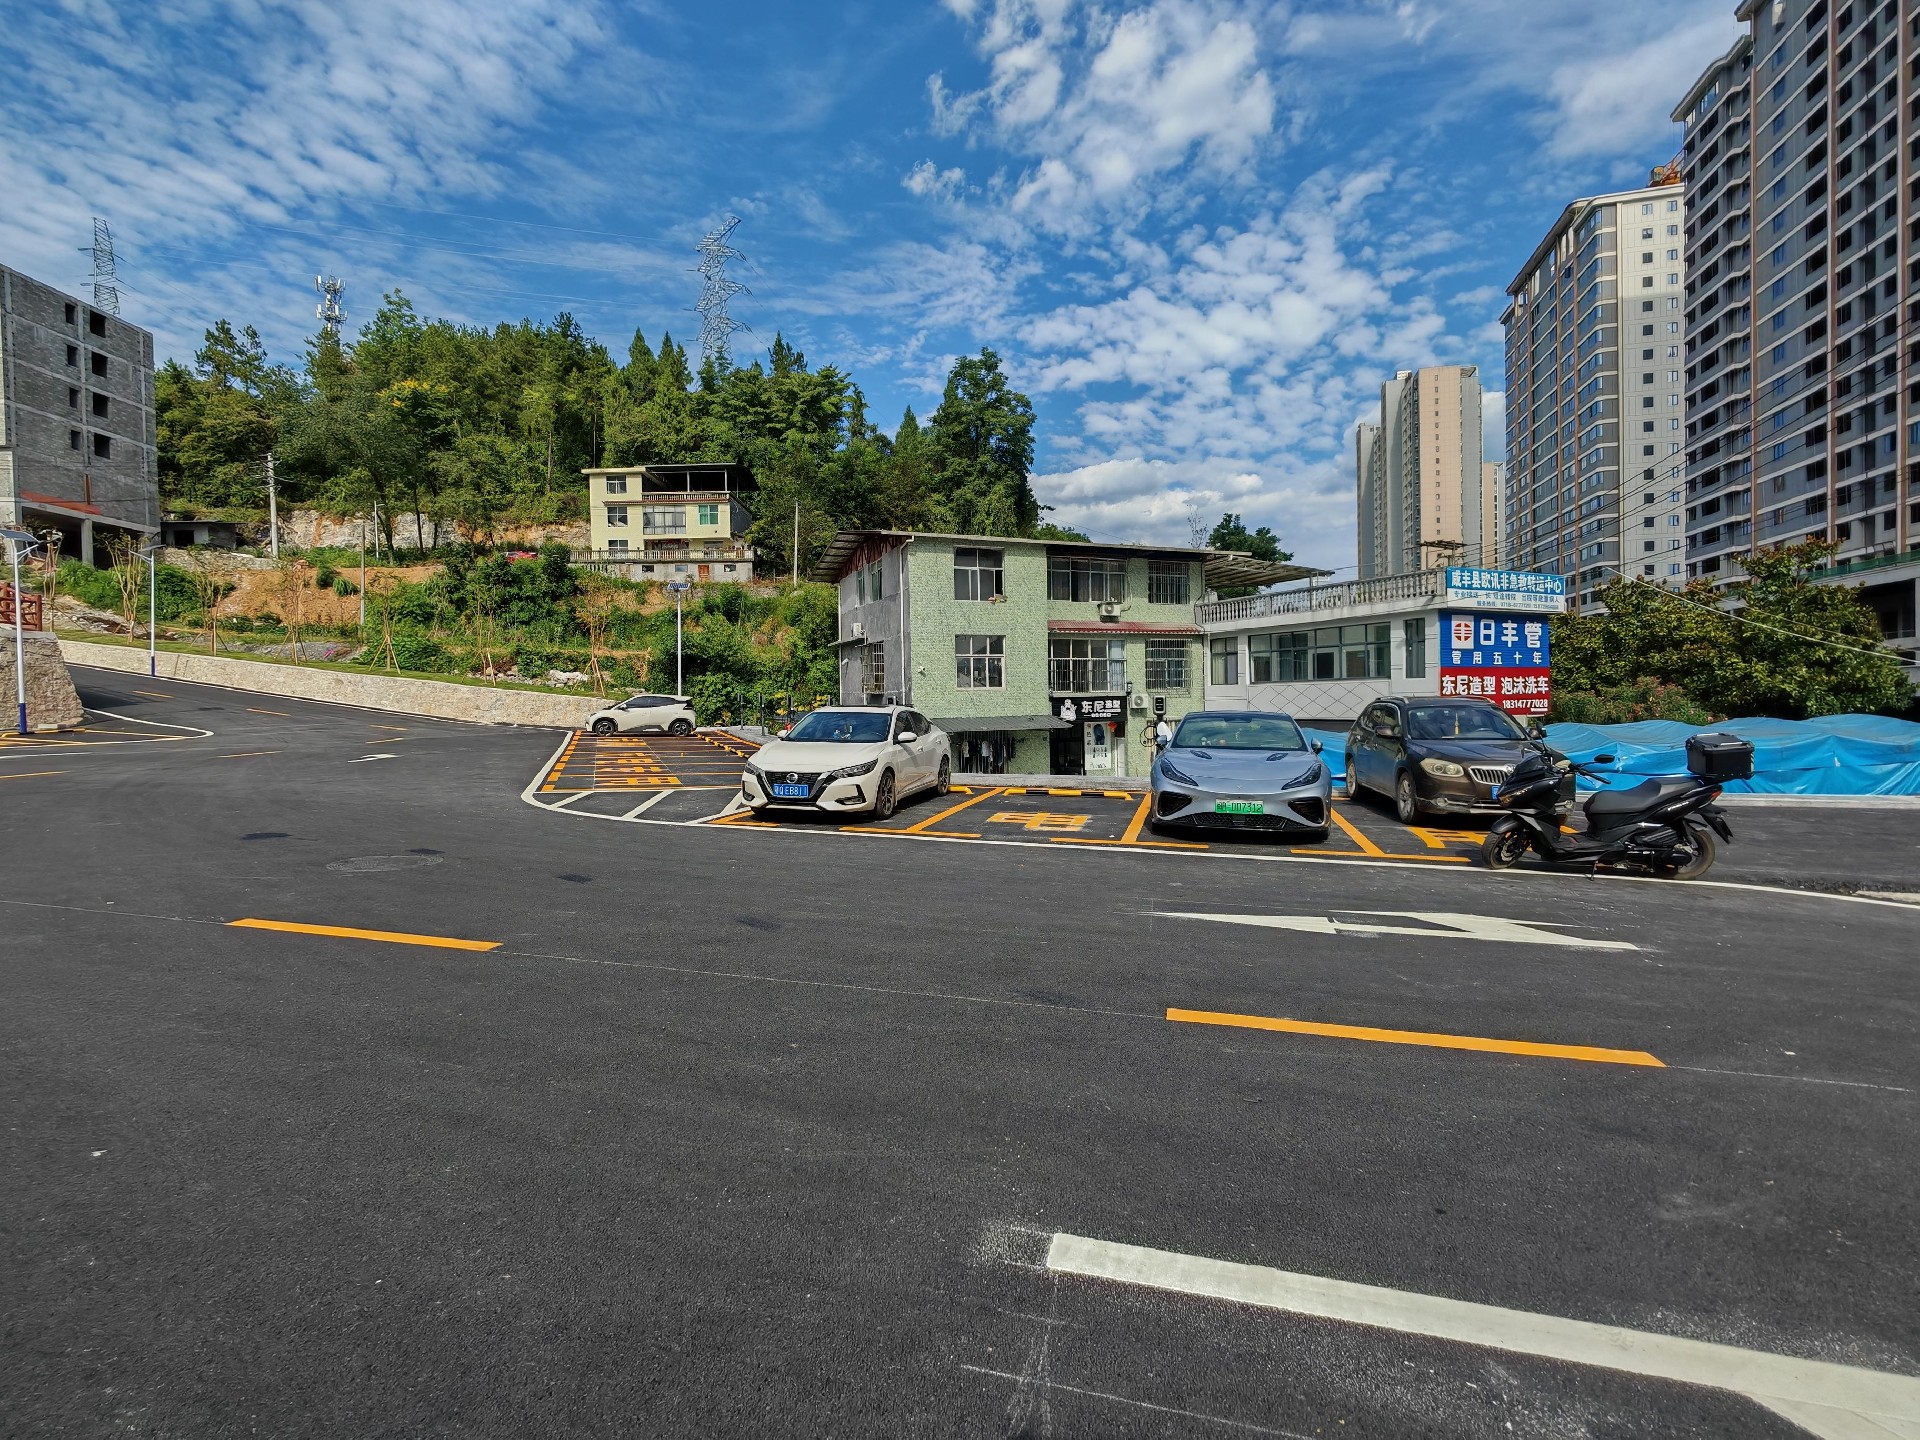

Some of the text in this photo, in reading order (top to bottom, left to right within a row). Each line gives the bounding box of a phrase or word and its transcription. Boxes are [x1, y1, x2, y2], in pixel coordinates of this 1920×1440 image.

[1480, 619, 1542, 648] 日丰管
[1451, 651, 1542, 665] 管用五十年
[1441, 675, 1549, 695] 东尼造型 泡沫洗车
[1502, 699, 1548, 709] 18314777028
